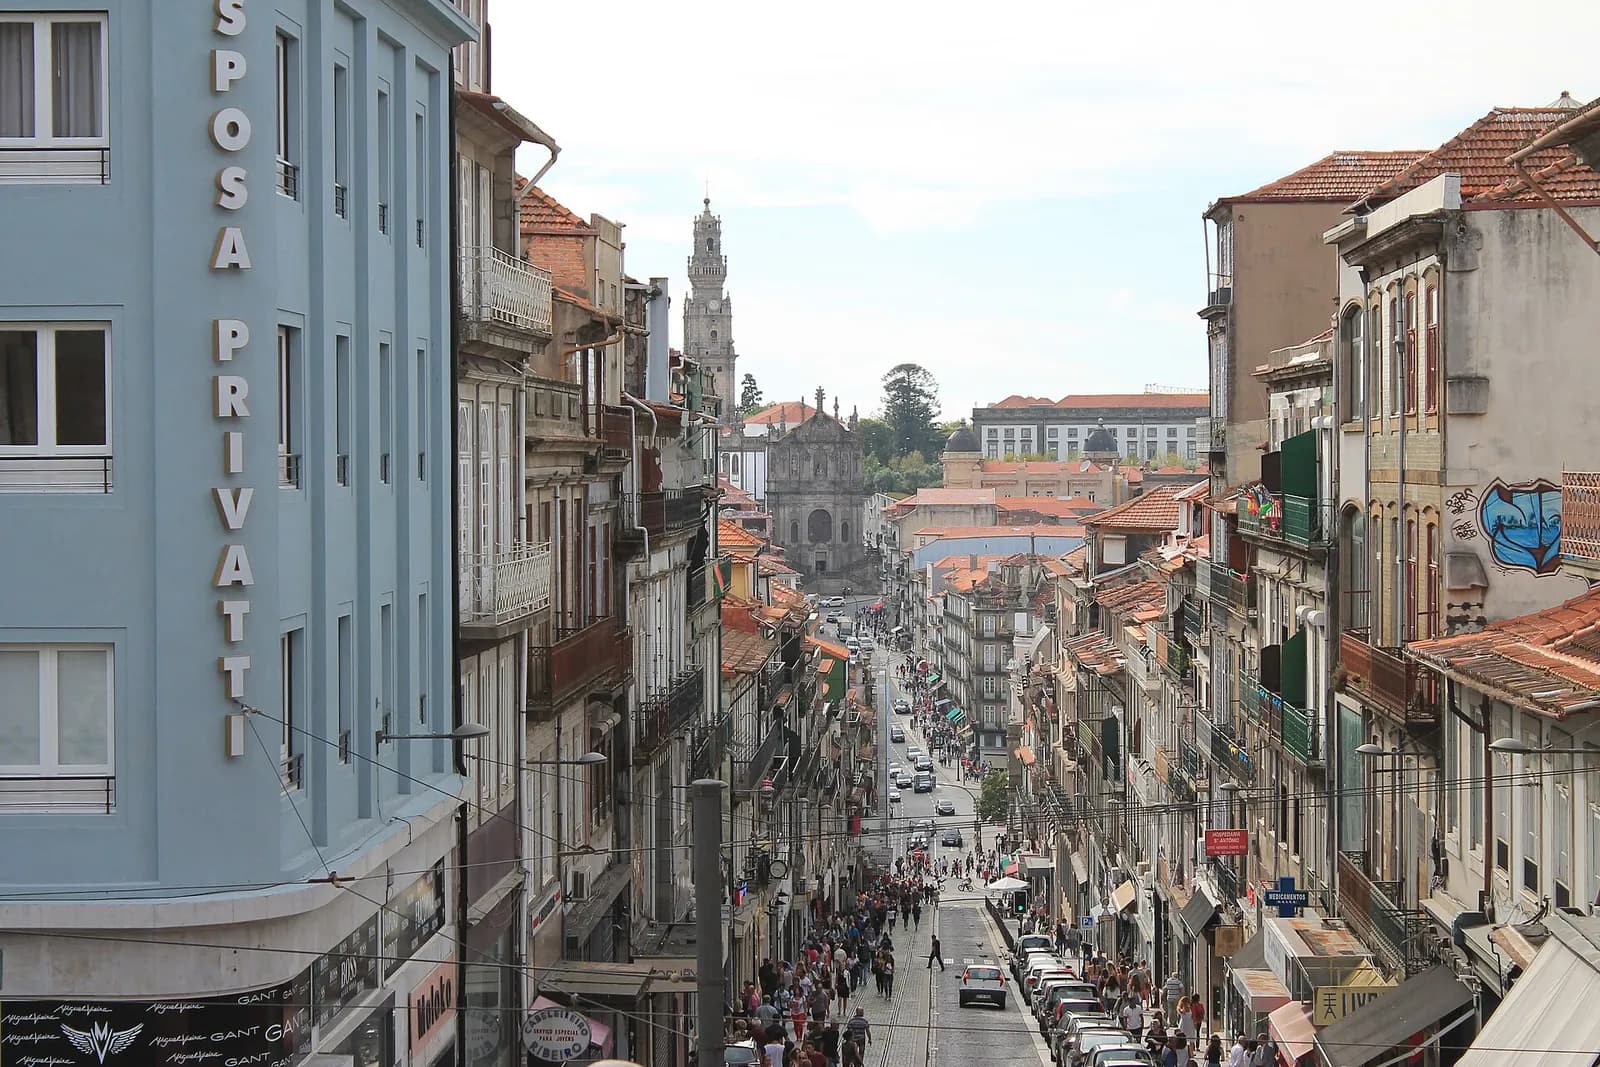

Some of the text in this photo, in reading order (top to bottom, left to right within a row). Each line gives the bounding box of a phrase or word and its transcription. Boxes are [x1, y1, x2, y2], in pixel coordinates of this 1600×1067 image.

[208, 0, 255, 757] SPOSA PRIVATTI
[341, 953, 357, 989] BOSS
[238, 989, 277, 1005] GANT
[417, 976, 451, 1040] Moloko
[211, 1026, 260, 1041] GANT
[265, 1008, 304, 1041] GANT
[555, 1028, 578, 1036] ESPECIAL
[225, 1052, 270, 1067] GANT
[529, 1041, 582, 1060] RIBEIRO
